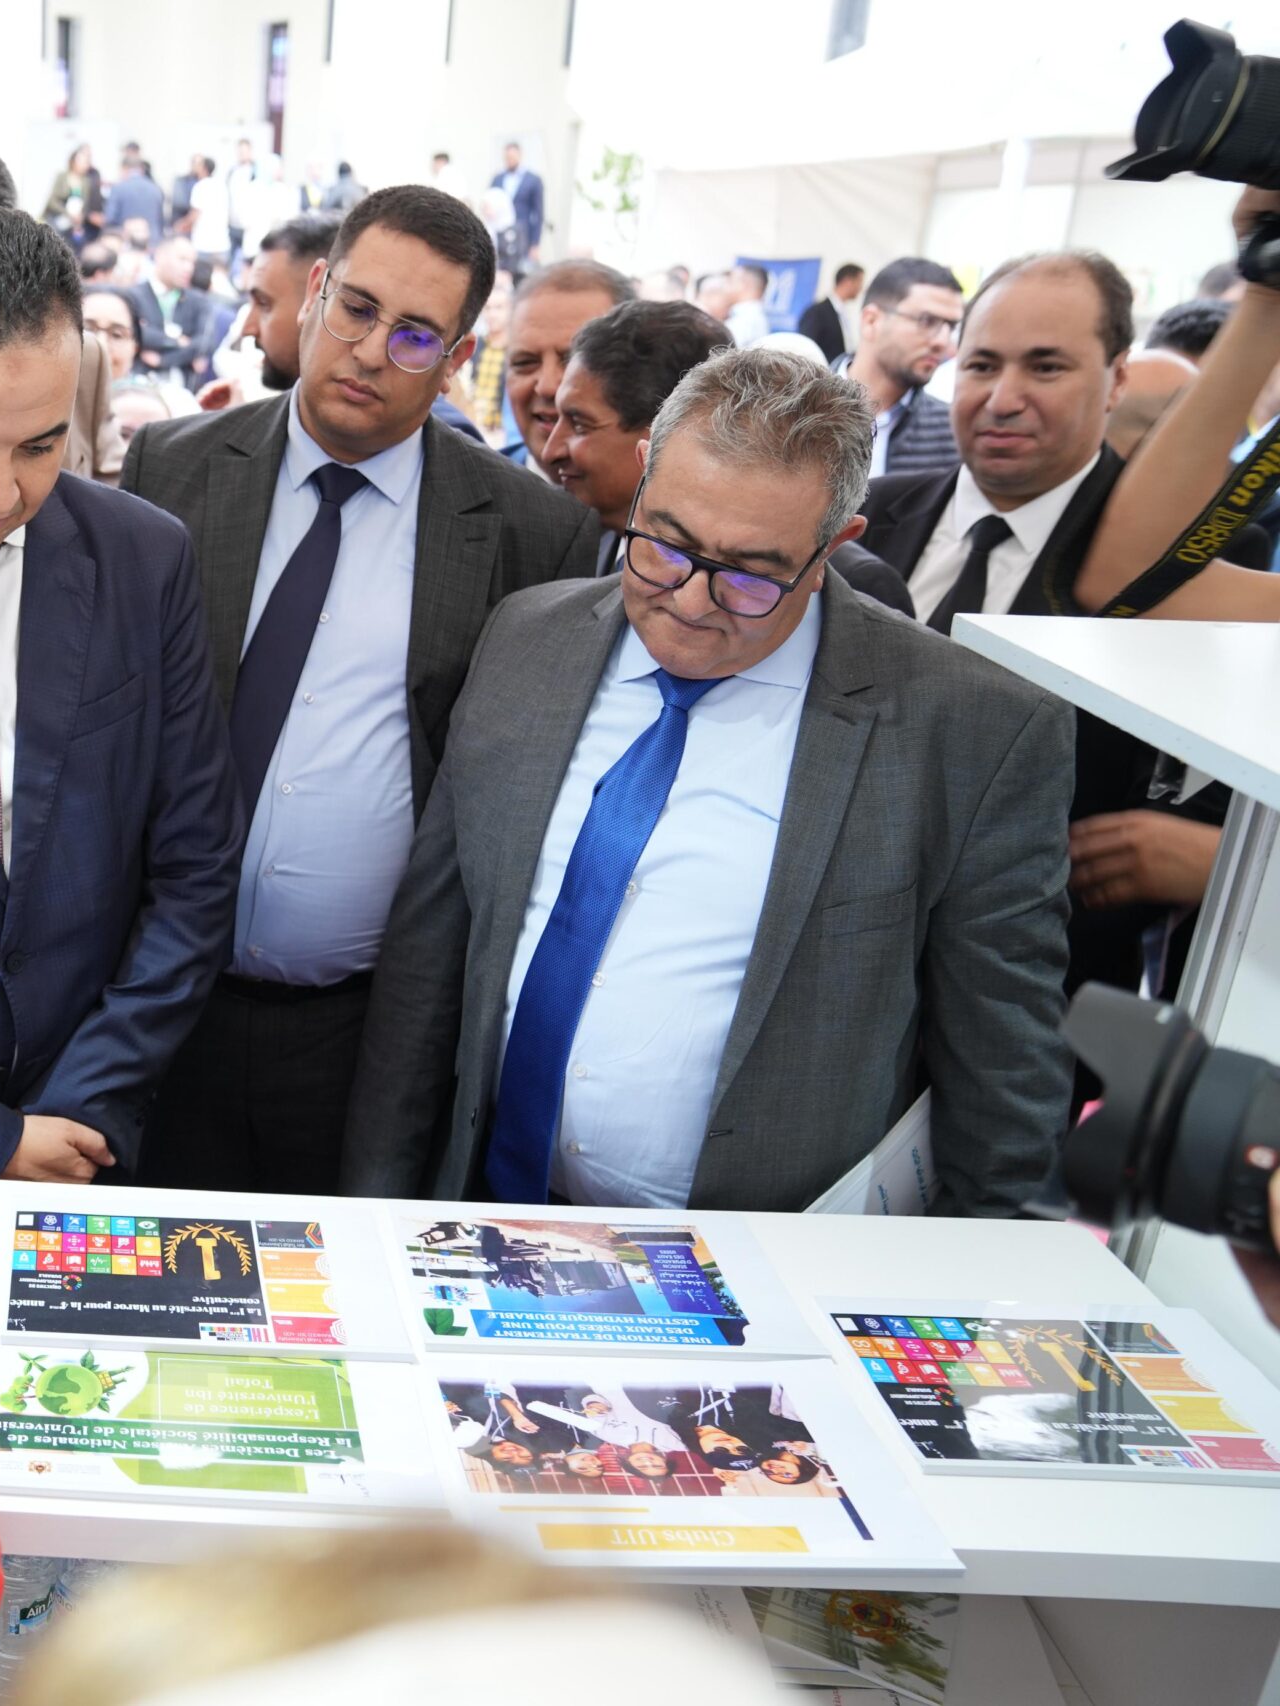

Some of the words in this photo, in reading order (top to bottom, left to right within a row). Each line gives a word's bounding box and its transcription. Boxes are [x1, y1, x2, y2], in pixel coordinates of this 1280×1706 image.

[1176, 506, 1248, 564] D850
[10, 1298, 46, 1308] année
[83, 1300, 112, 1308] pour
[192, 1296, 260, 1305] consécutive
[70, 1302, 82, 1310] la
[113, 1303, 150, 1312] Maroc
[169, 1304, 228, 1314] université
[247, 1308, 262, 1316] La
[486, 1311, 555, 1321] DURABLE
[558, 1314, 634, 1324] HYDRIQUE
[637, 1317, 700, 1326] GESTION
[501, 1320, 532, 1329] UNE
[534, 1322, 574, 1330] POUR
[576, 1324, 622, 1333] USÉES
[494, 1330, 589, 1340] TRAITEMENT
[624, 1326, 662, 1334] EAUX
[616, 1334, 677, 1344] STATION
[680, 1336, 712, 1344] UNE
[224, 1376, 272, 1389] Tofail
[184, 1389, 211, 1401] Ibn
[182, 1404, 204, 1414] de
[208, 1403, 320, 1420] L'expérience
[896, 1418, 938, 1428] année
[93, 1426, 114, 1438] de
[120, 1427, 197, 1441] Sociétale
[7, 1434, 28, 1445] de
[34, 1435, 127, 1450] Nationales
[202, 1432, 330, 1447] Responsabilité
[335, 1437, 352, 1448] la
[200, 1444, 299, 1458] Deuxièmes
[304, 1448, 336, 1460] Les
[610, 1528, 658, 1545] UIT
[662, 1529, 736, 1546] Clubs
